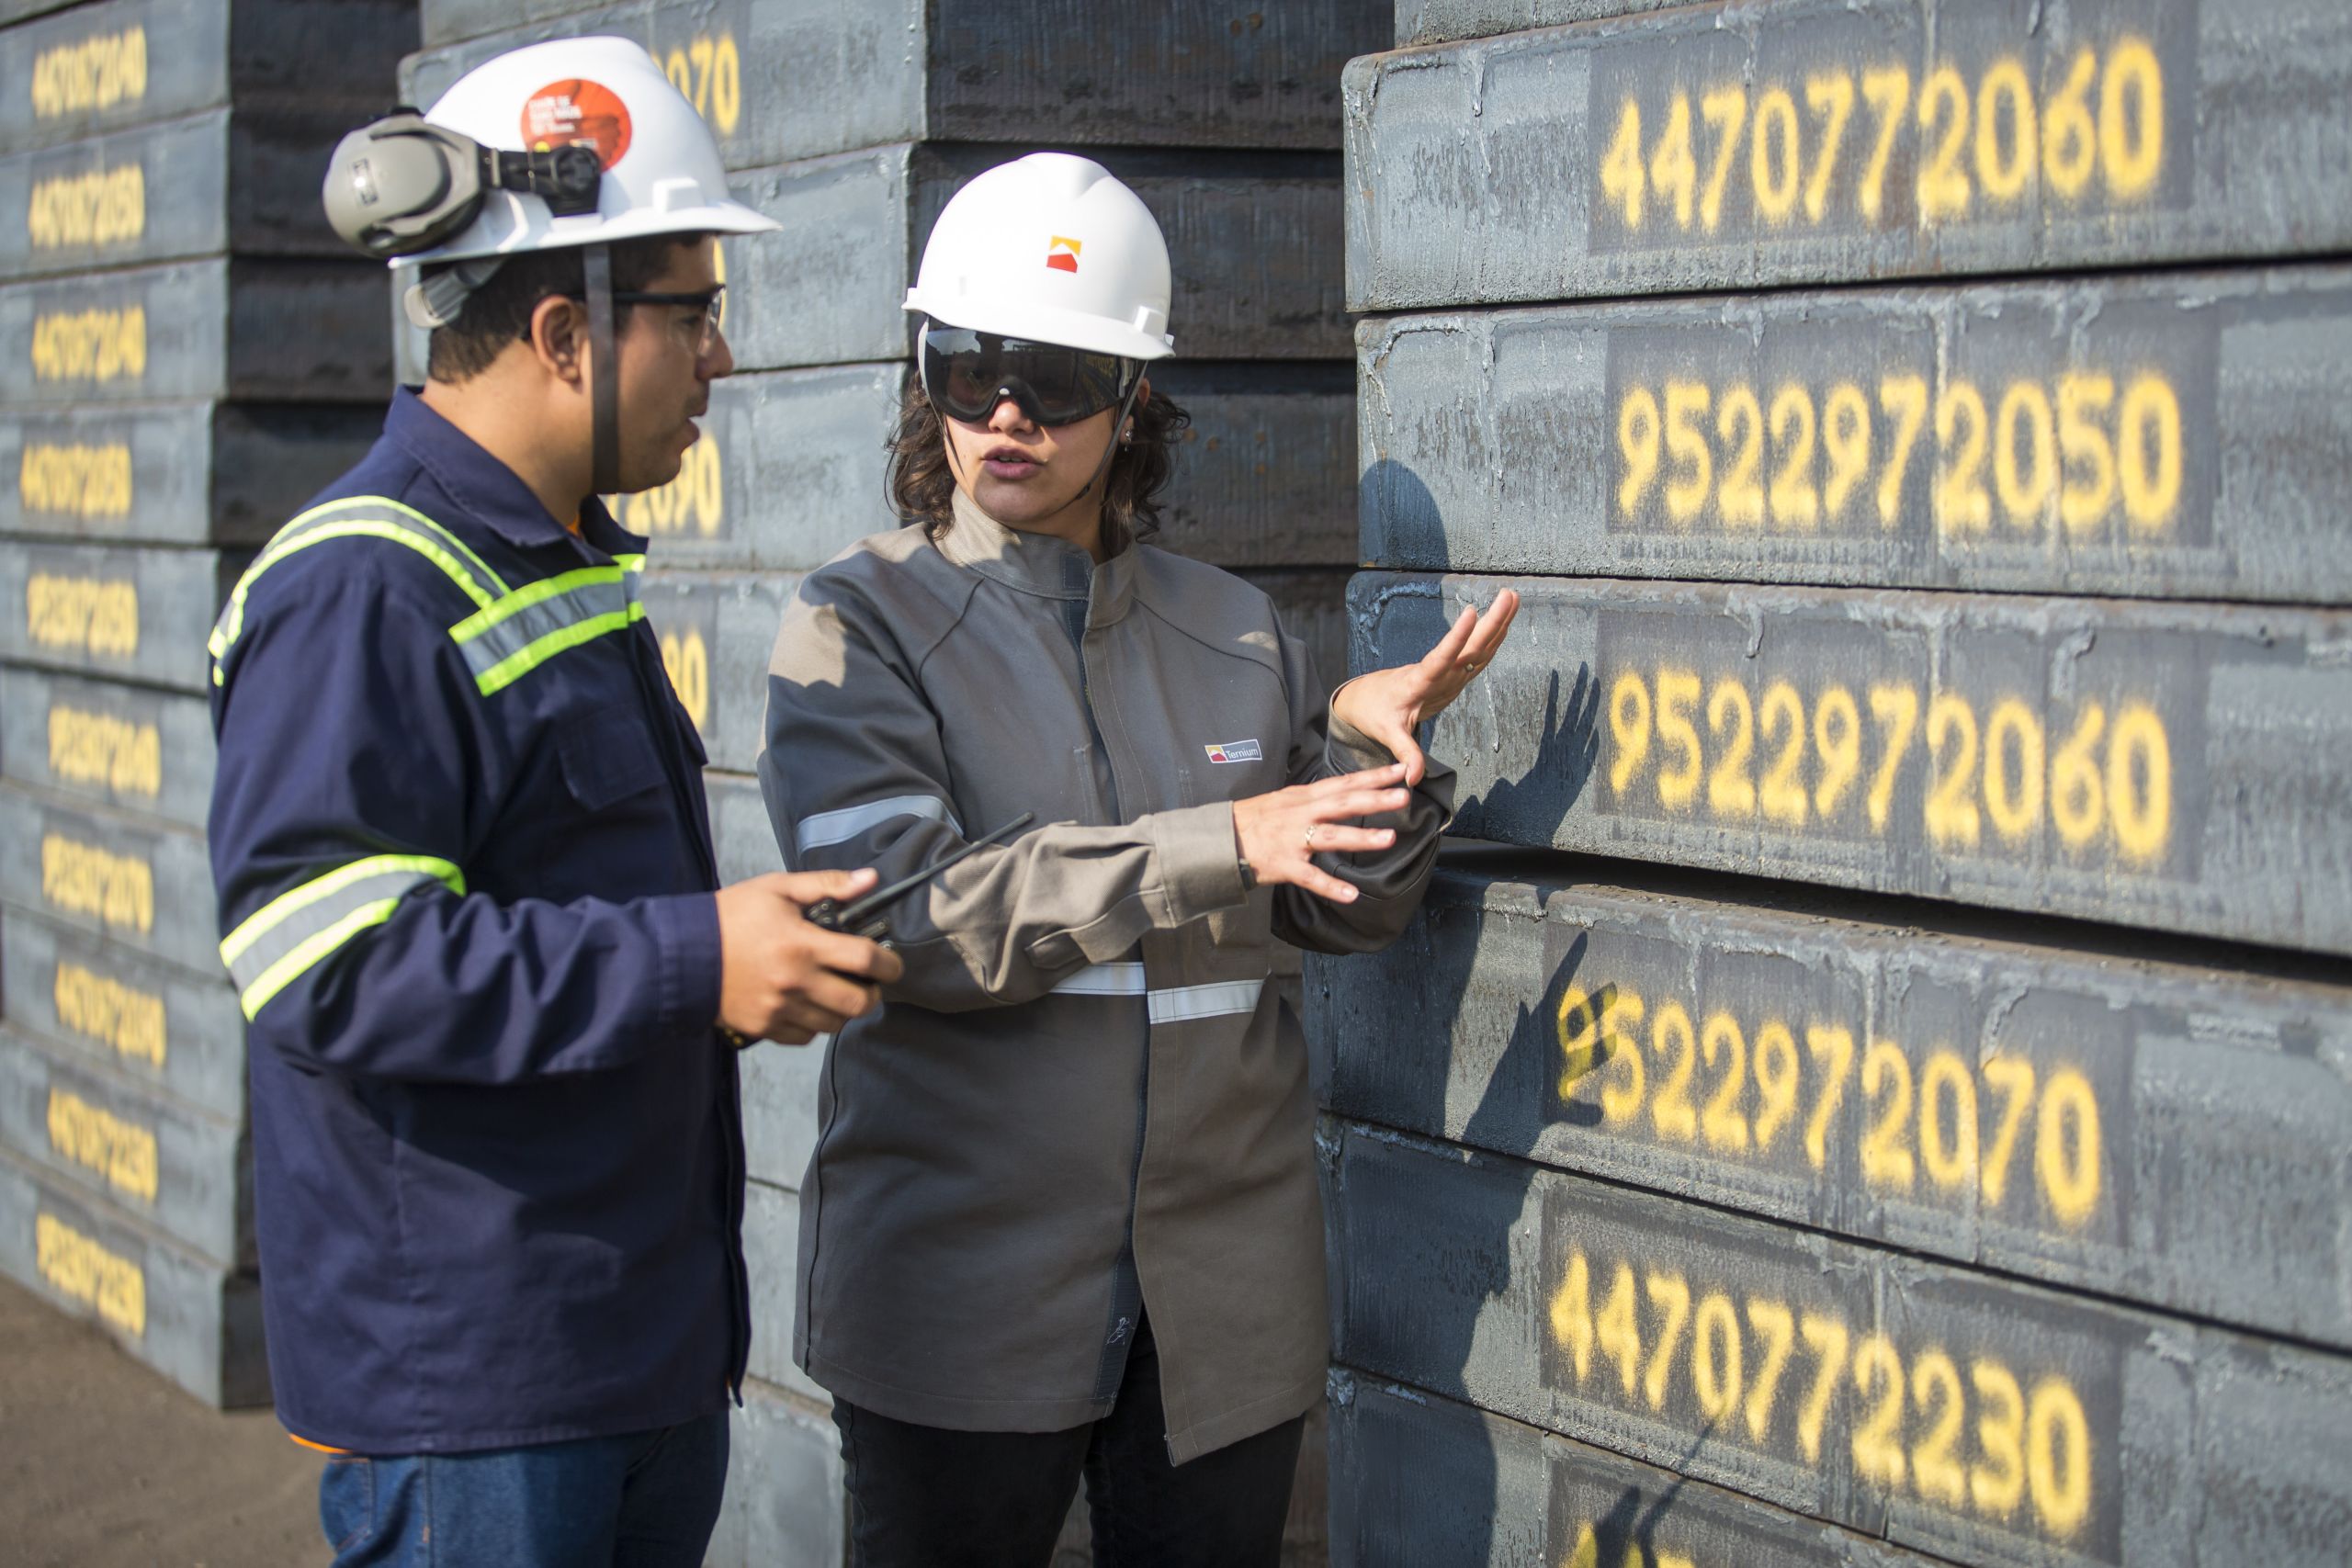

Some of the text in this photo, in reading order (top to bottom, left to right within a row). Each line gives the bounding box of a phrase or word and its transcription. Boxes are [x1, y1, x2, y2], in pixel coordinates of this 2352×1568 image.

[1601, 39, 2163, 228] 4470772060
[1619, 372, 2182, 531] 9522972050
[1225, 747, 1259, 760] Ternium
[1610, 668, 2170, 861] 9522972060
[1557, 984, 2100, 1224] 9522972070
[1549, 1251, 2091, 1536] 4470772230
